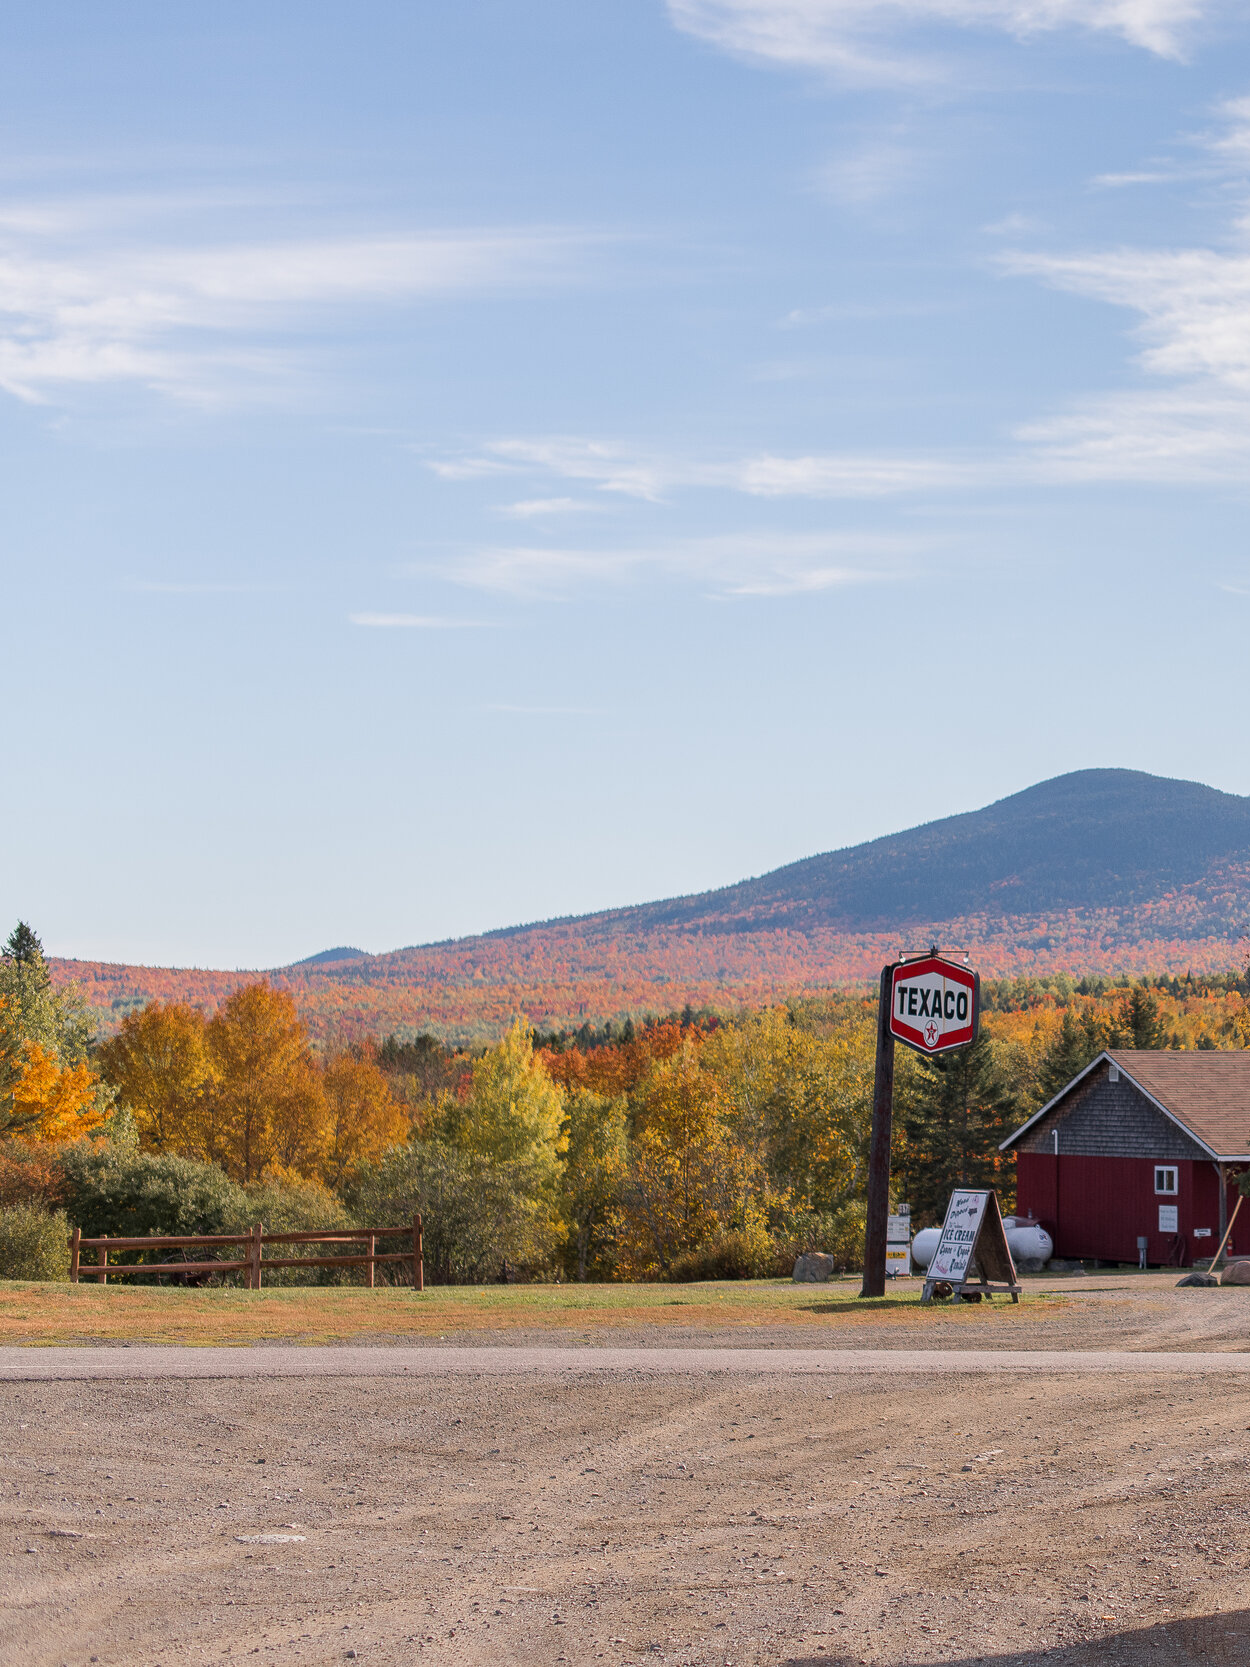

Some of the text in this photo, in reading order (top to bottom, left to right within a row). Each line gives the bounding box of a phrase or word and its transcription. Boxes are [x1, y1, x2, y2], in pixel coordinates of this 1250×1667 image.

[898, 987, 968, 1021] TEXACO
[943, 1229, 975, 1242] ICE CREAM
